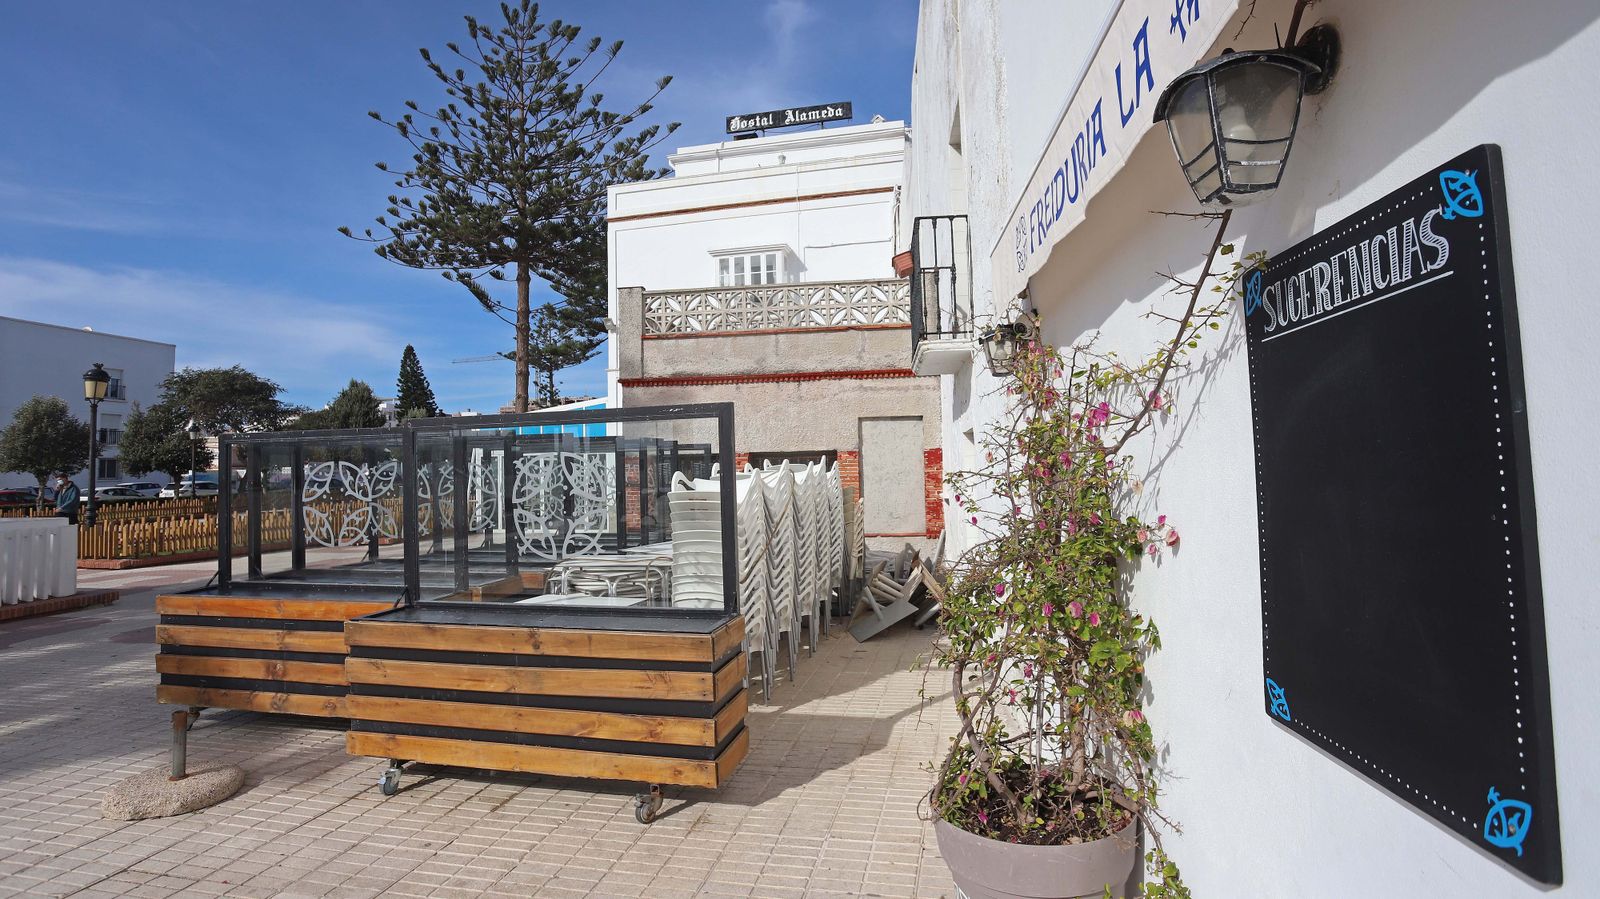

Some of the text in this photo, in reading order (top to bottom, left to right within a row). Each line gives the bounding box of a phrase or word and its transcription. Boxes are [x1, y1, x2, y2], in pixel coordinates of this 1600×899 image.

[785, 106, 843, 125] Alameda
[1029, 15, 1155, 254] FREIDURIA LA
[1262, 203, 1450, 333] SUGERENCIAS
